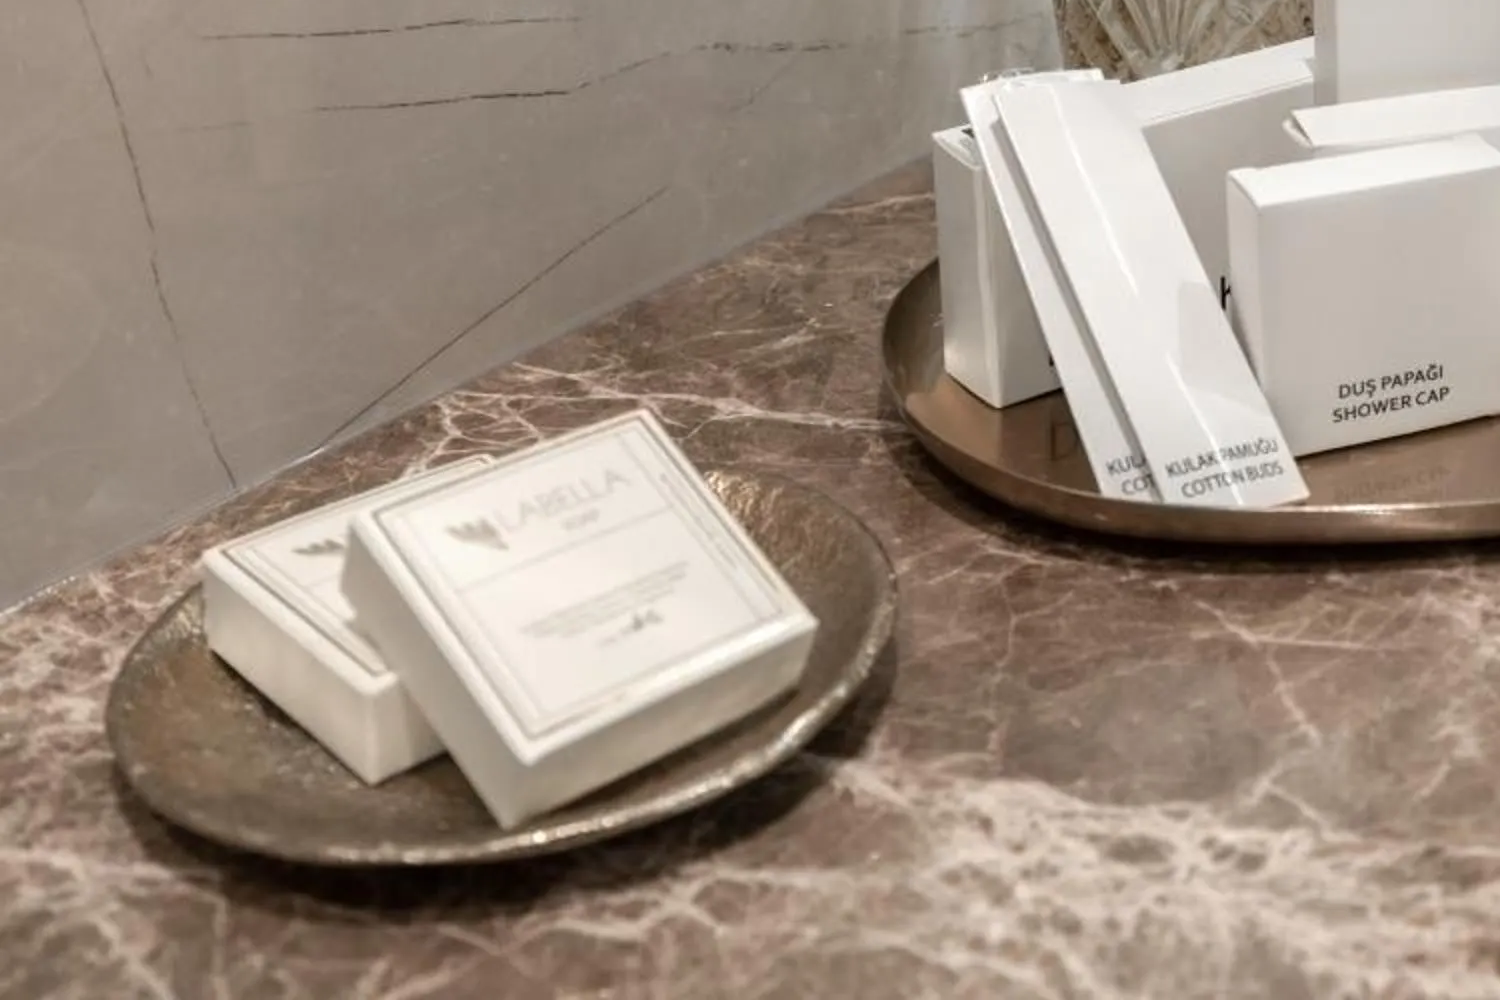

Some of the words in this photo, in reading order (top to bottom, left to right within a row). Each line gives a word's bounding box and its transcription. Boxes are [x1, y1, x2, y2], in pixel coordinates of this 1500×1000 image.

[1338, 378, 1377, 399] DUŞ
[1381, 363, 1444, 390] PAPAĞI
[1331, 394, 1412, 423] SHOWER
[1415, 385, 1451, 406] CAP
[1164, 451, 1220, 478] KULAK
[1180, 466, 1245, 498] COTTON
[1246, 460, 1284, 483] BUDS
